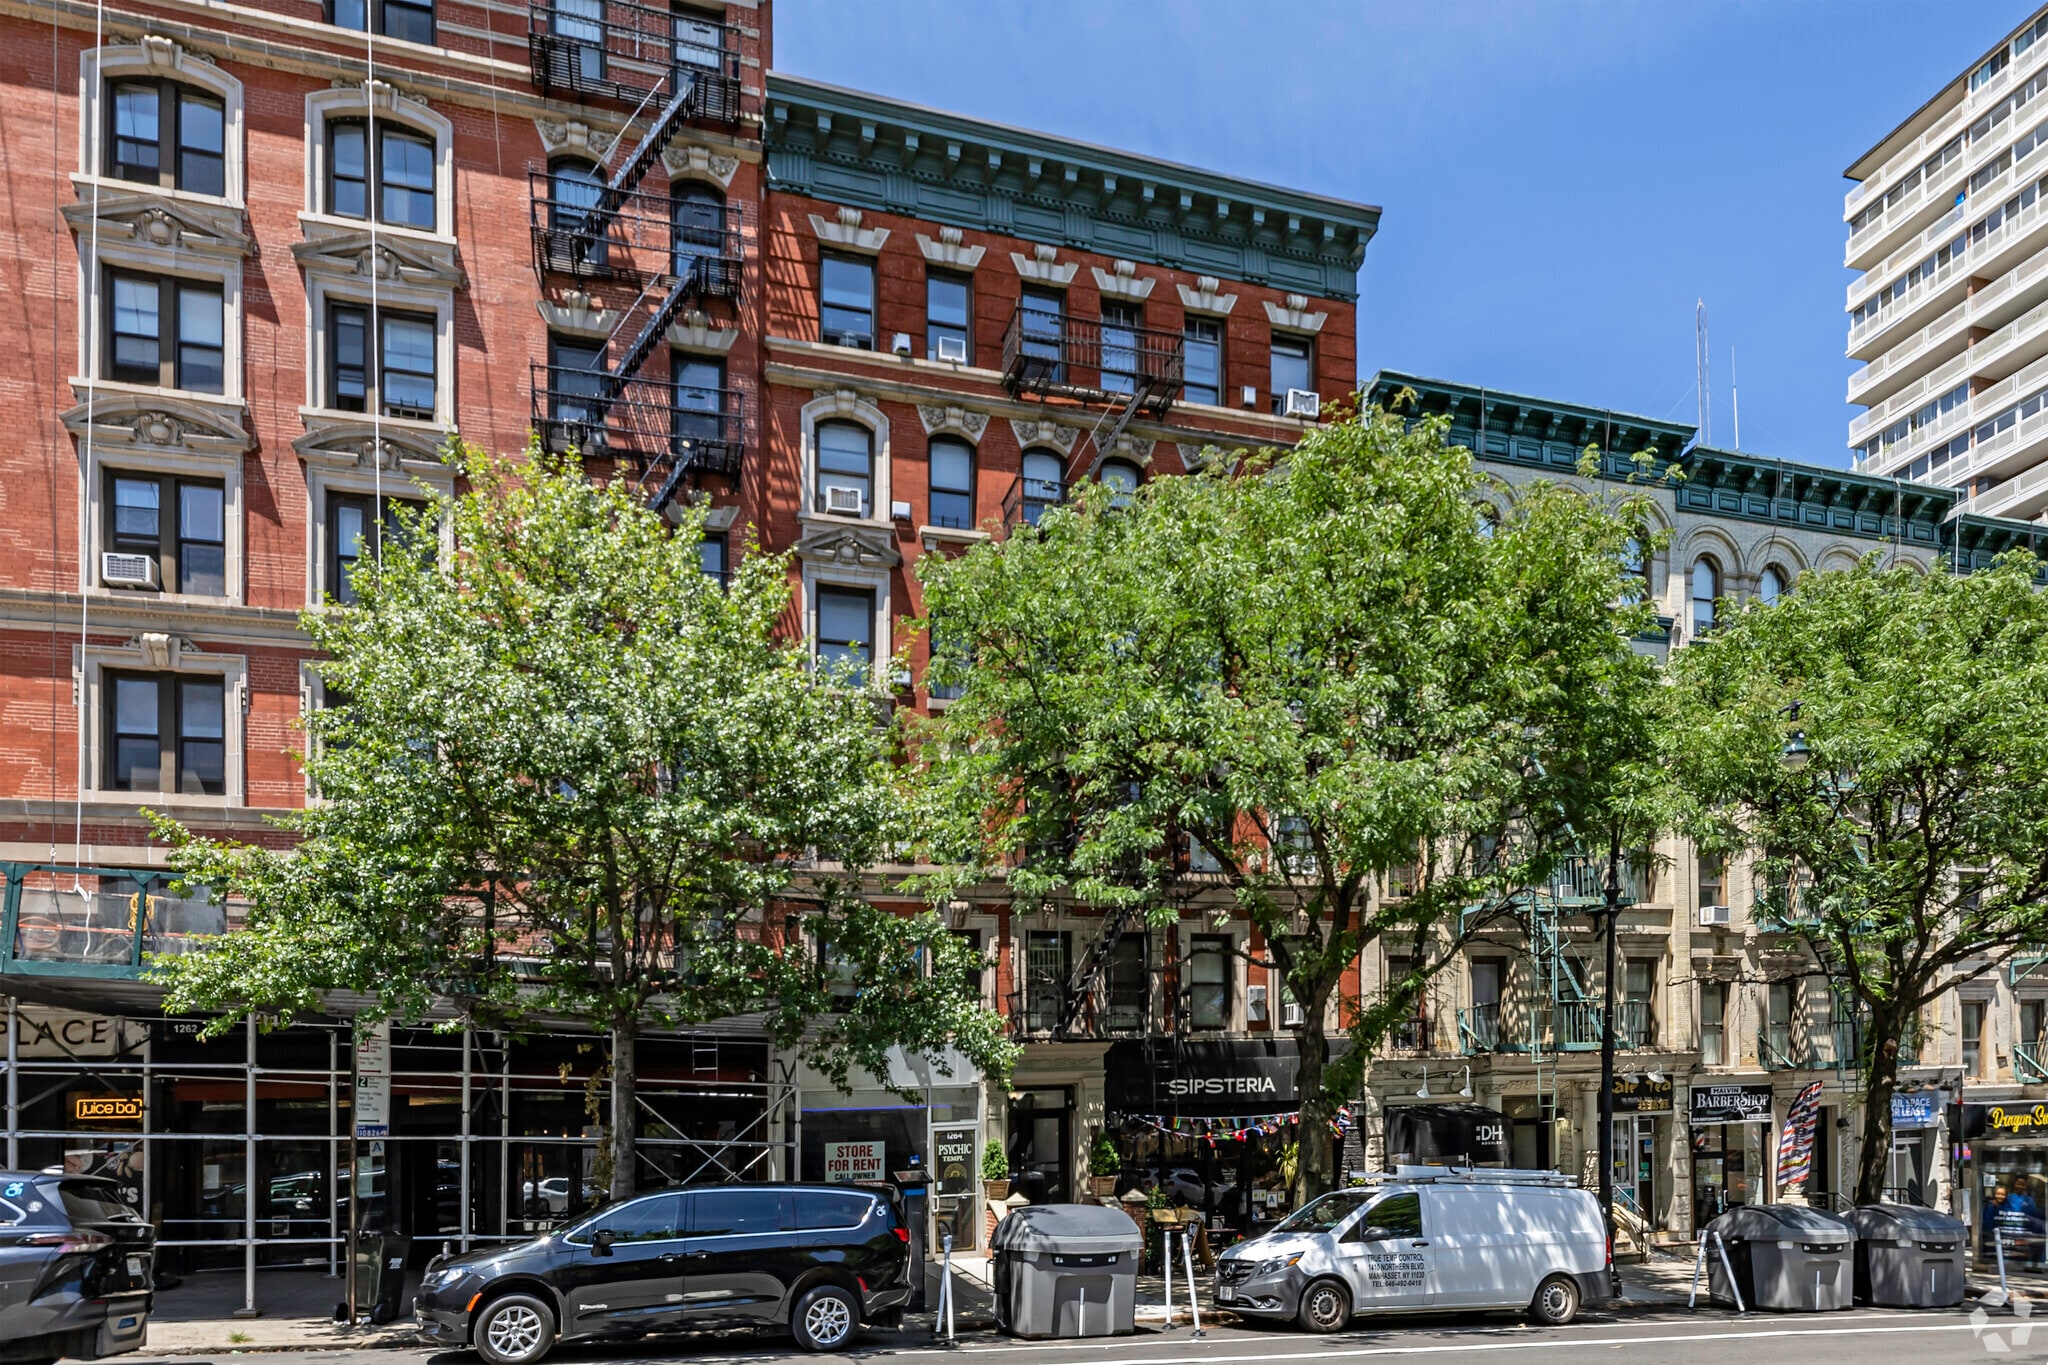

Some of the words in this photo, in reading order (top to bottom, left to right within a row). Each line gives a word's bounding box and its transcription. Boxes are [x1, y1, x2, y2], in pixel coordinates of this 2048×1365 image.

[174, 1024, 197, 1033] 1262
[1168, 1077, 1276, 1095] SIPSTERIA
[81, 1102, 113, 1116] juice
[1901, 1106, 1926, 1117] LEASE
[1990, 1106, 2032, 1133] Dragon
[946, 1131, 963, 1140] 1264
[1481, 1125, 1504, 1141] DH
[372, 1142, 382, 1152] A
[836, 1145, 873, 1158] STORE
[937, 1143, 973, 1156] PSYCHIC
[828, 1159, 849, 1172] FOR
[853, 1158, 882, 1171] RENT
[834, 1172, 849, 1181] CALL
[852, 1171, 876, 1180] OWNER
[1268, 1195, 1275, 1204] A
[1367, 1254, 1382, 1263] TRUE
[1383, 1254, 1398, 1262] TEMP
[1398, 1253, 1425, 1262] CONTROL
[1381, 1262, 1410, 1271] NORTHERN
[1402, 1271, 1411, 1279] NY
[1411, 1271, 1425, 1279] 11030
